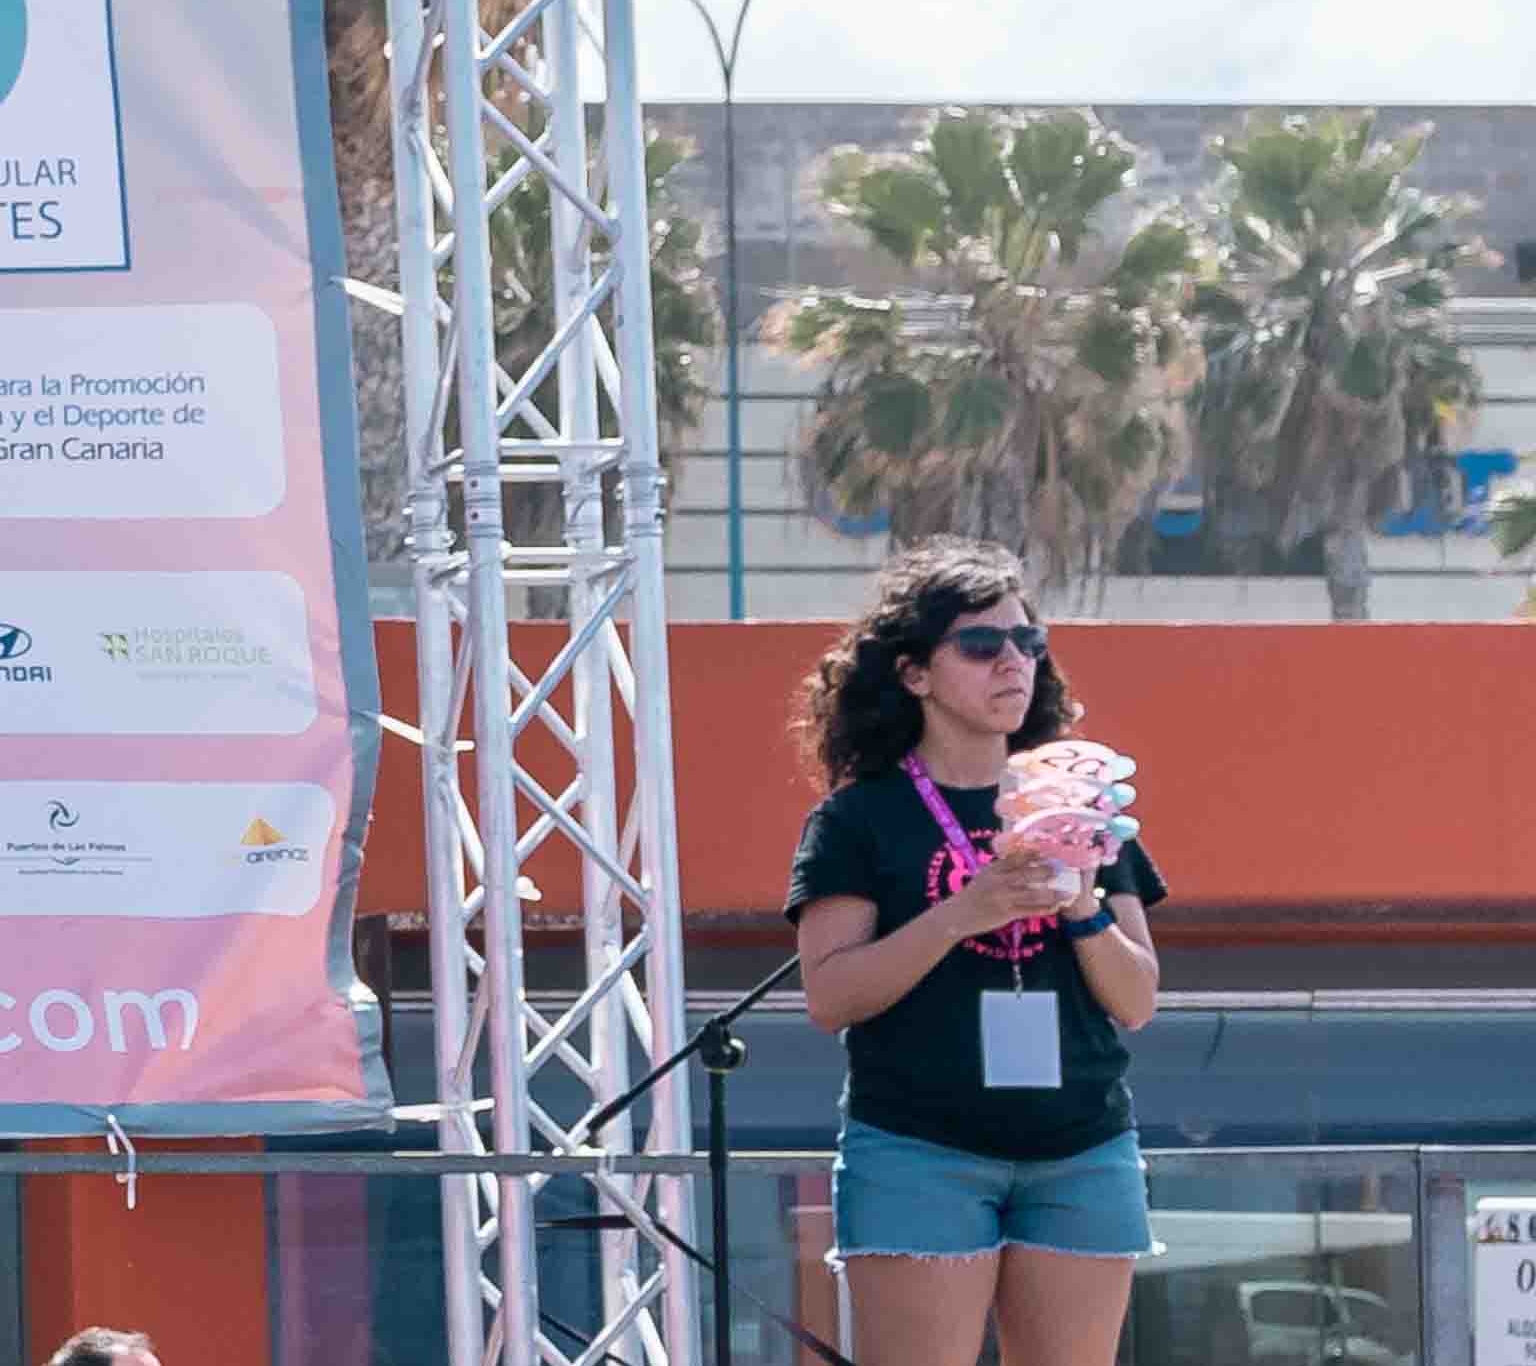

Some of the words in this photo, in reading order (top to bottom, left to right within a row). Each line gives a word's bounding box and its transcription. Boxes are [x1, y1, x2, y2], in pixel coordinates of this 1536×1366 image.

[42, 374, 62, 396] la
[71, 372, 206, 397] Promoción
[12, 410, 27, 432] y
[34, 404, 55, 426] el
[63, 405, 165, 431] Deporte
[173, 403, 205, 425] de
[62, 437, 165, 460] Canaria
